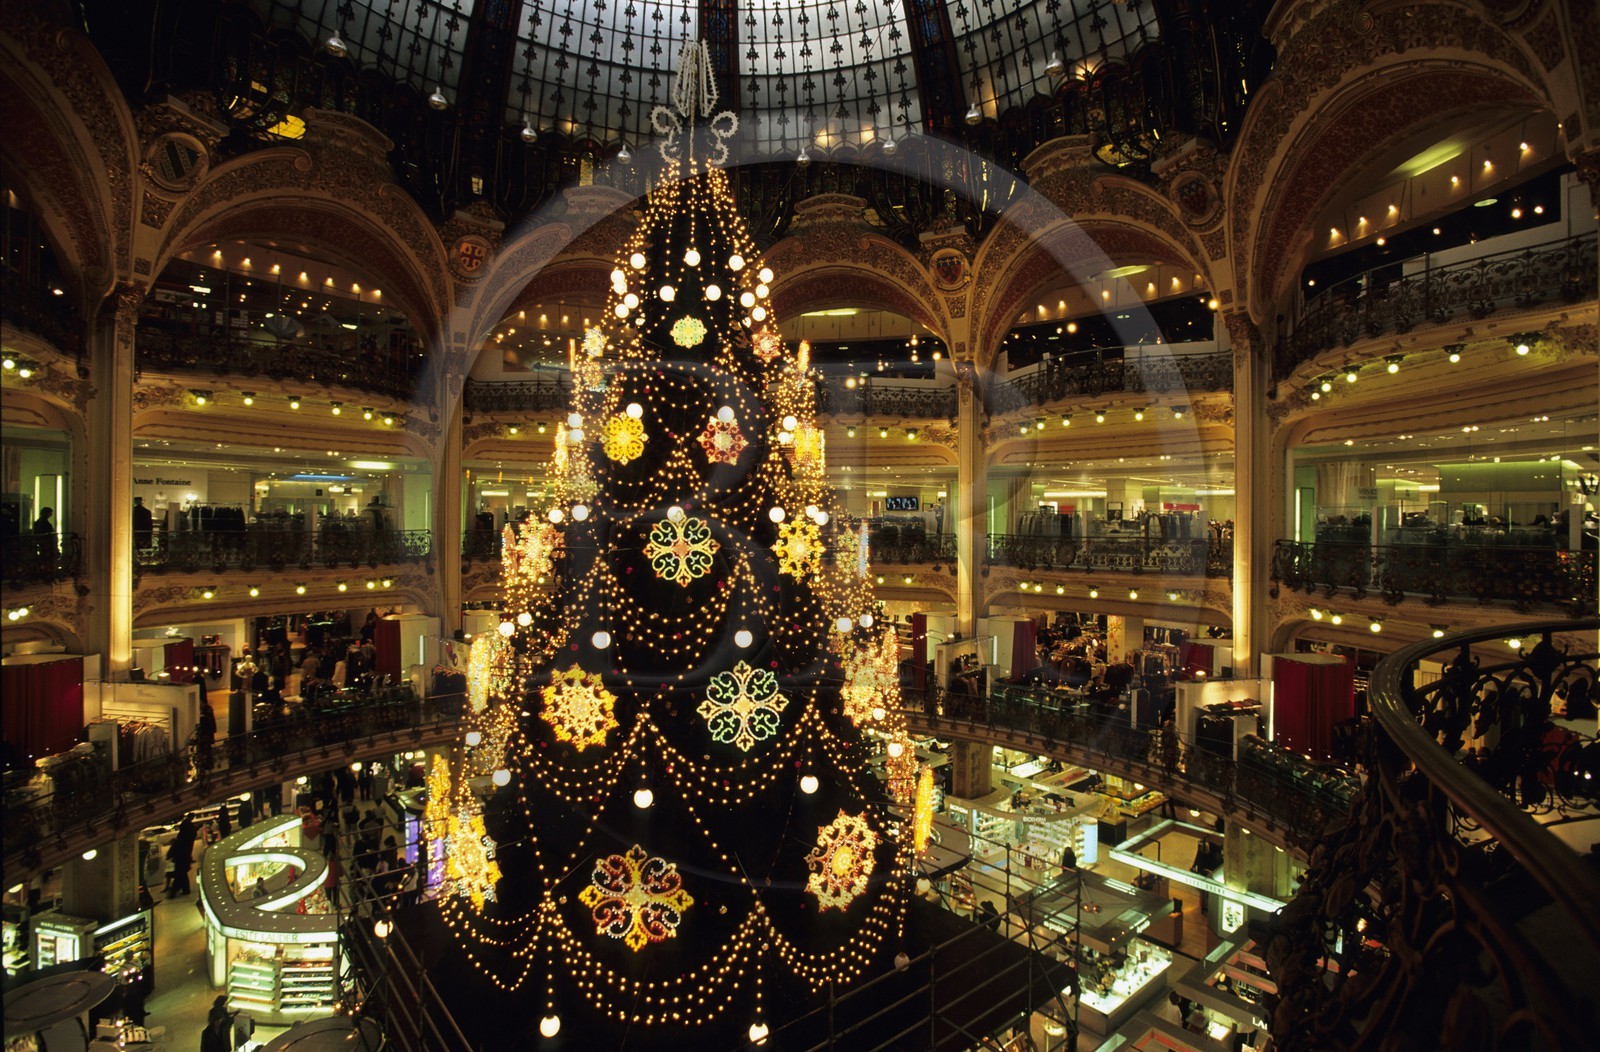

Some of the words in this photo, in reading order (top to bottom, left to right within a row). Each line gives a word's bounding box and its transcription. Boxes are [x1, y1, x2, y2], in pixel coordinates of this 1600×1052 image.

[133, 477, 153, 485] Anne
[156, 477, 191, 486] Fontaine
[55, 924, 74, 932] JACOBS
[261, 932, 298, 943] LAUDER
